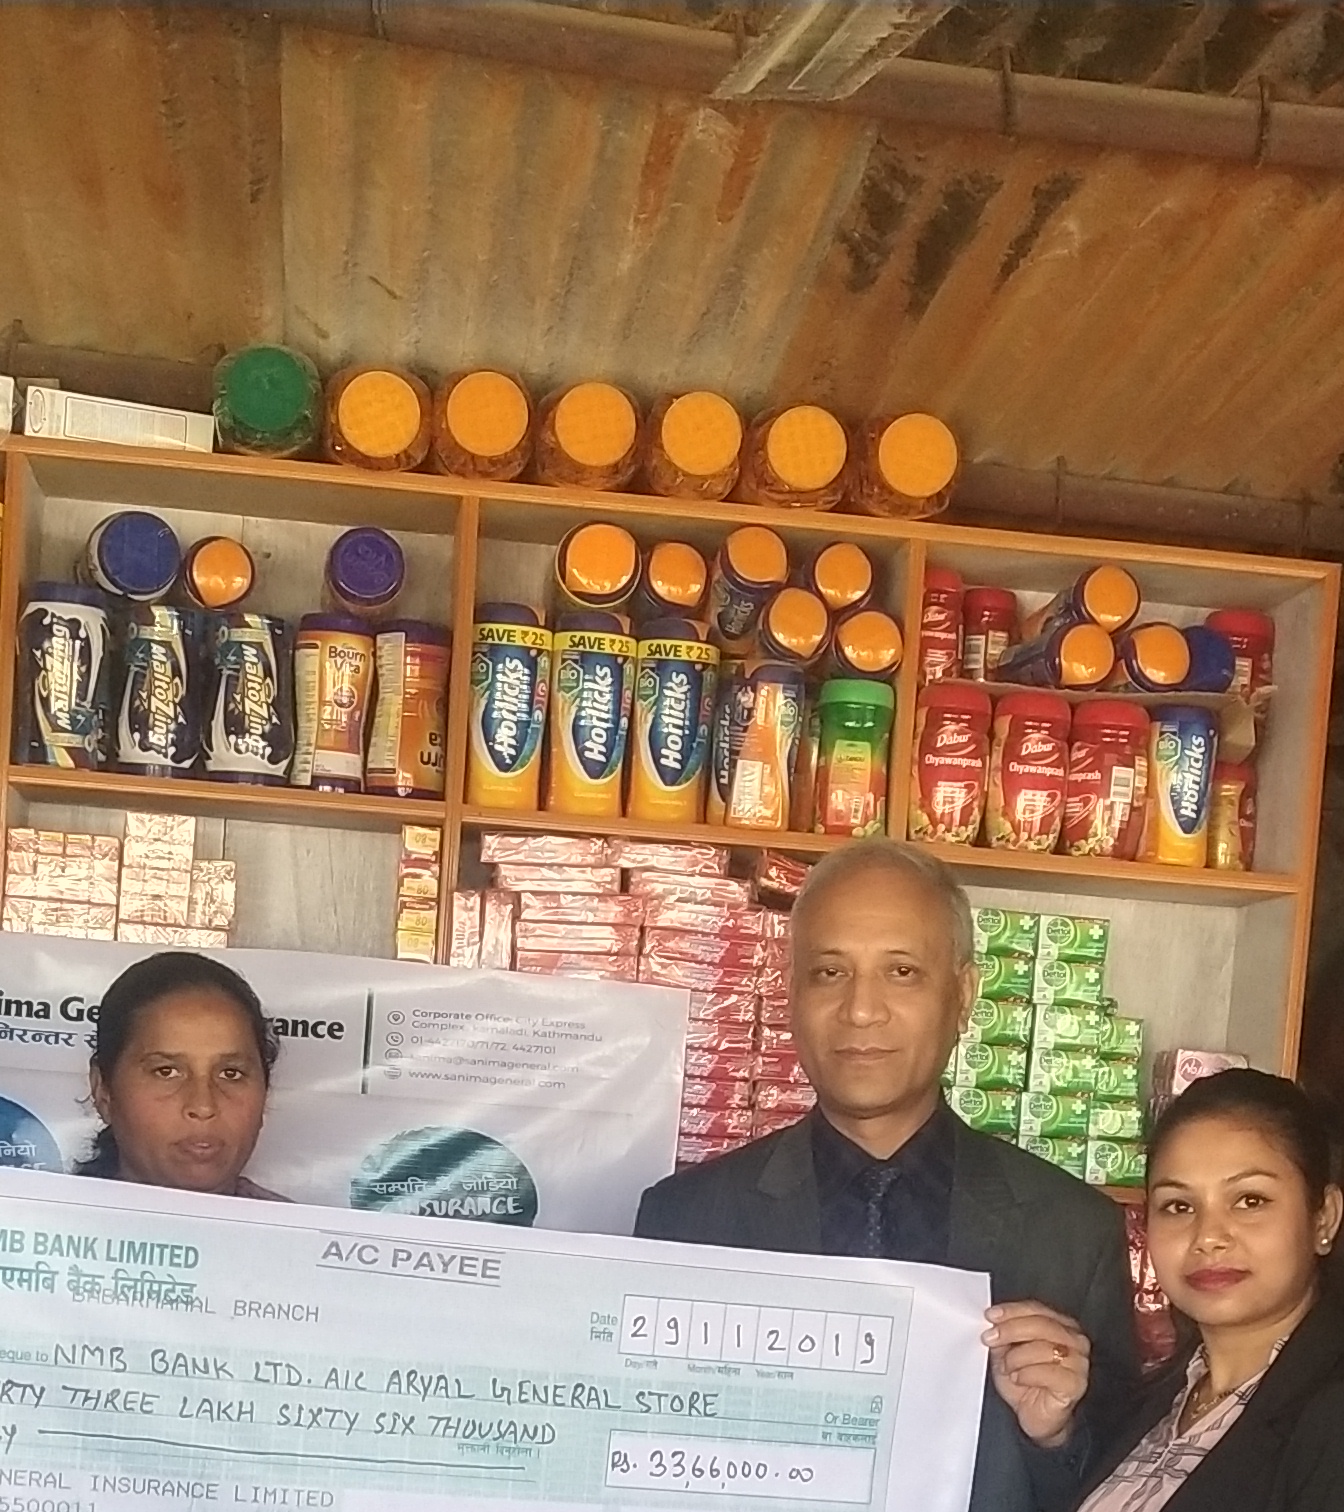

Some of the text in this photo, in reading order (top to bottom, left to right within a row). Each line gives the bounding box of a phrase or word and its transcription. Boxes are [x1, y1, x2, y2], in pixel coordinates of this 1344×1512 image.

[479, 627, 517, 644] SAVE
[568, 634, 606, 652] SAVE
[328, 645, 366, 663] Bourn
[646, 642, 682, 658] SAVE
[584, 665, 612, 763] Horlicks
[659, 671, 689, 770] Horlicks
[936, 731, 972, 748] Dabur
[1021, 740, 1056, 756] Dabur
[924, 753, 983, 769] Chyawanprash
[1179, 734, 1206, 818] Horlicks
[977, 915, 1002, 925] Dettol
[1047, 927, 1071, 937] Dettol
[1043, 969, 1067, 979] Dettol
[412, 1008, 473, 1023] Corporate
[532, 1027, 604, 1043] Kathmandu
[965, 1051, 990, 1061] Dettol
[959, 1097, 984, 1107] Dettol
[1029, 1101, 1054, 1112] Dettol
[32, 1231, 98, 1261] BANK
[105, 1237, 200, 1270] LIMITED
[322, 1239, 502, 1281] A/C PAYEE
[233, 1300, 320, 1324] BRANCH
[590, 1311, 619, 1326] Date
[35, 1350, 49, 1363] to
[54, 1343, 720, 1418] NMB BANK LTD. ARYAL GENERAL STORE
[61, 1385, 158, 1416] THREE
[178, 1396, 256, 1424] LAKH
[276, 1404, 360, 1437] SIXTY
[374, 1411, 416, 1437] SIX
[426, 1414, 557, 1446] THOUSAND
[823, 1412, 880, 1428] Or Bearer
[89, 1473, 219, 1501] INSURANCE
[234, 1481, 335, 1509] LIMITED
